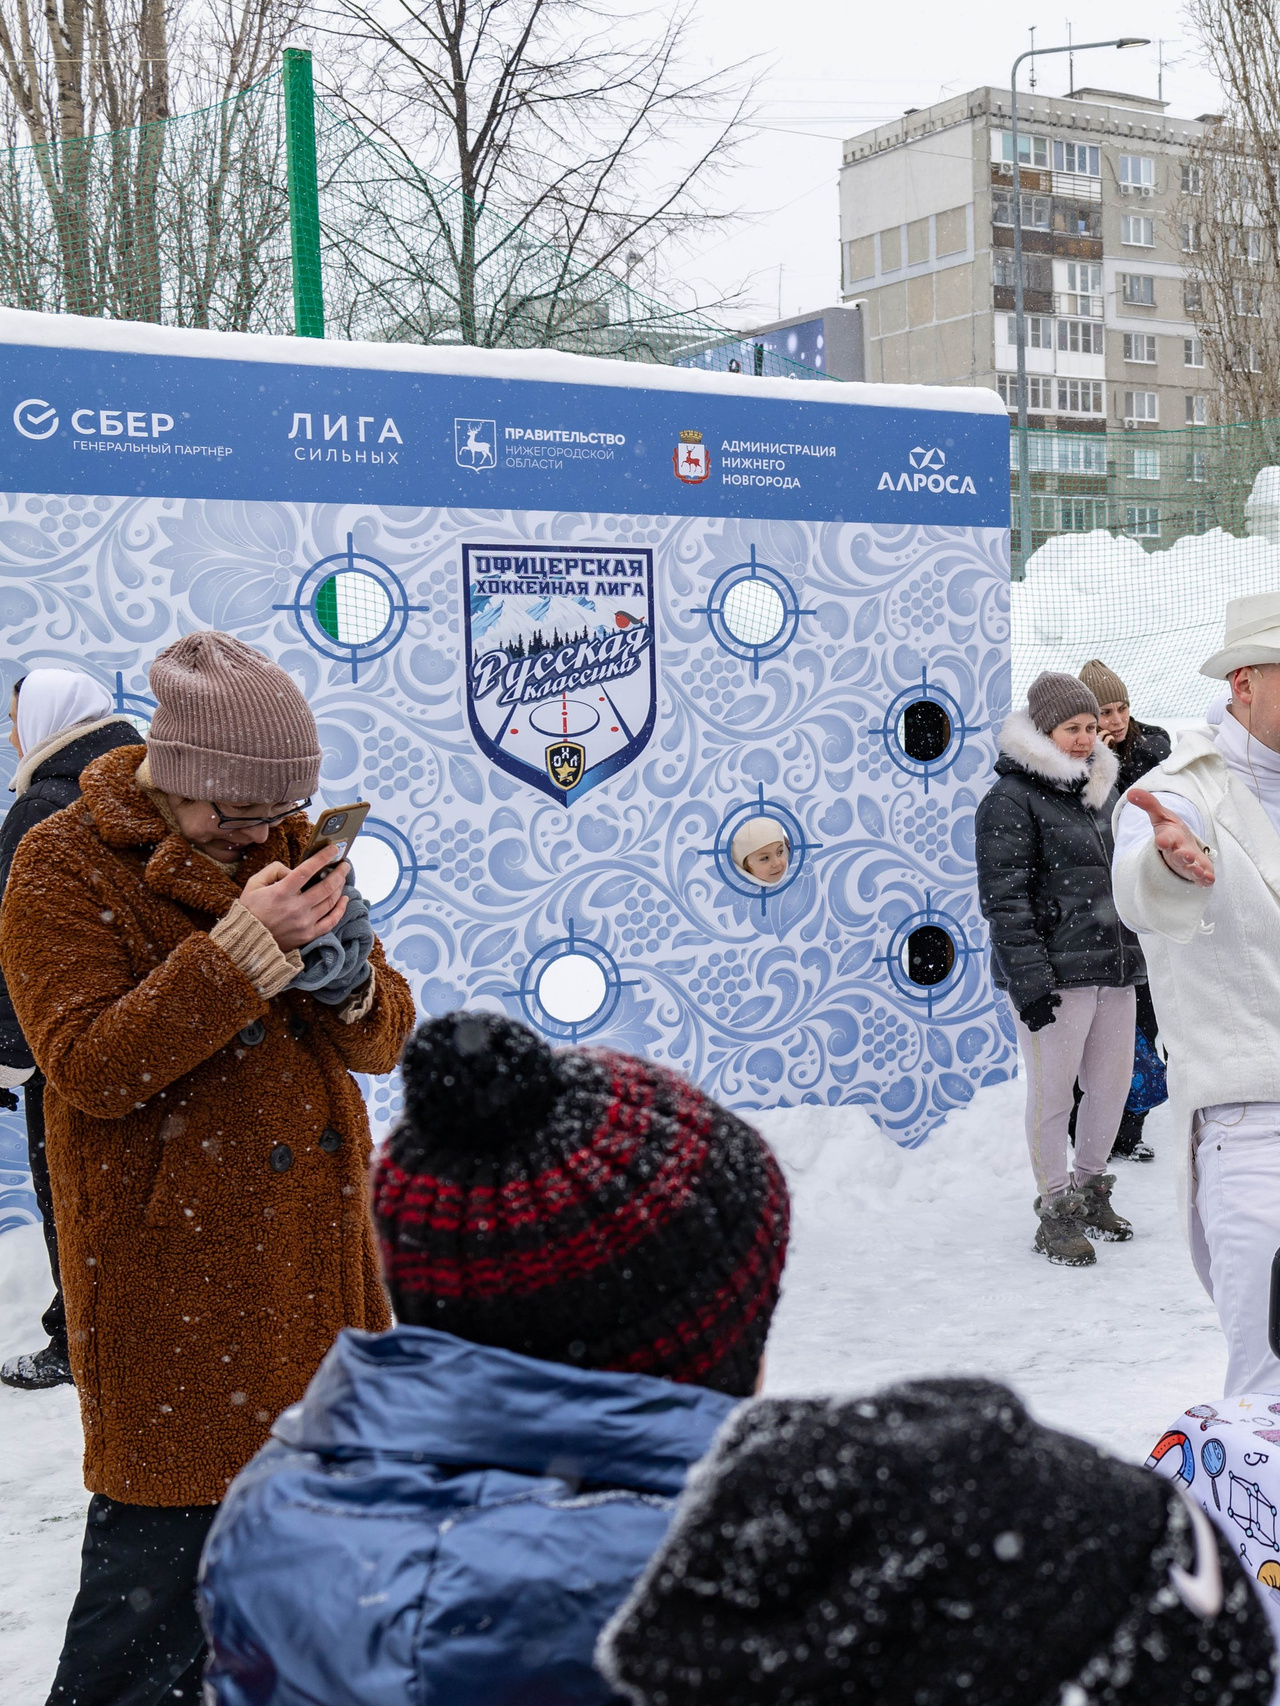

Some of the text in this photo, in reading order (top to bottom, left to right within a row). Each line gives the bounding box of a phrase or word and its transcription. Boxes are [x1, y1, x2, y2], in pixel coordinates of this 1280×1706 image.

[71, 409, 174, 438] СБЕР
[288, 412, 403, 444] ЛИГА
[505, 427, 626, 446] ПРАВИТЕЛЬСТВО
[73, 440, 233, 457] ГЕНЕРАЛЬНЫЙ ПАРТНЁР
[294, 447, 400, 464] СИЛЬНЫХ
[505, 445, 615, 460] НИЖЕГОРОДСКОЙ
[721, 440, 836, 457] АДМИНИСТРАЦИЯ
[505, 458, 563, 470] ОБЛАСТИ
[722, 457, 785, 471] НИЖНЕГО
[722, 474, 801, 489] НОВГОРОДА
[877, 472, 977, 494] АЛРОСА
[474, 555, 644, 578] ОФИЦЕРСКАЯ
[595, 581, 645, 597] ЛИГА
[473, 627, 650, 704] Русская
